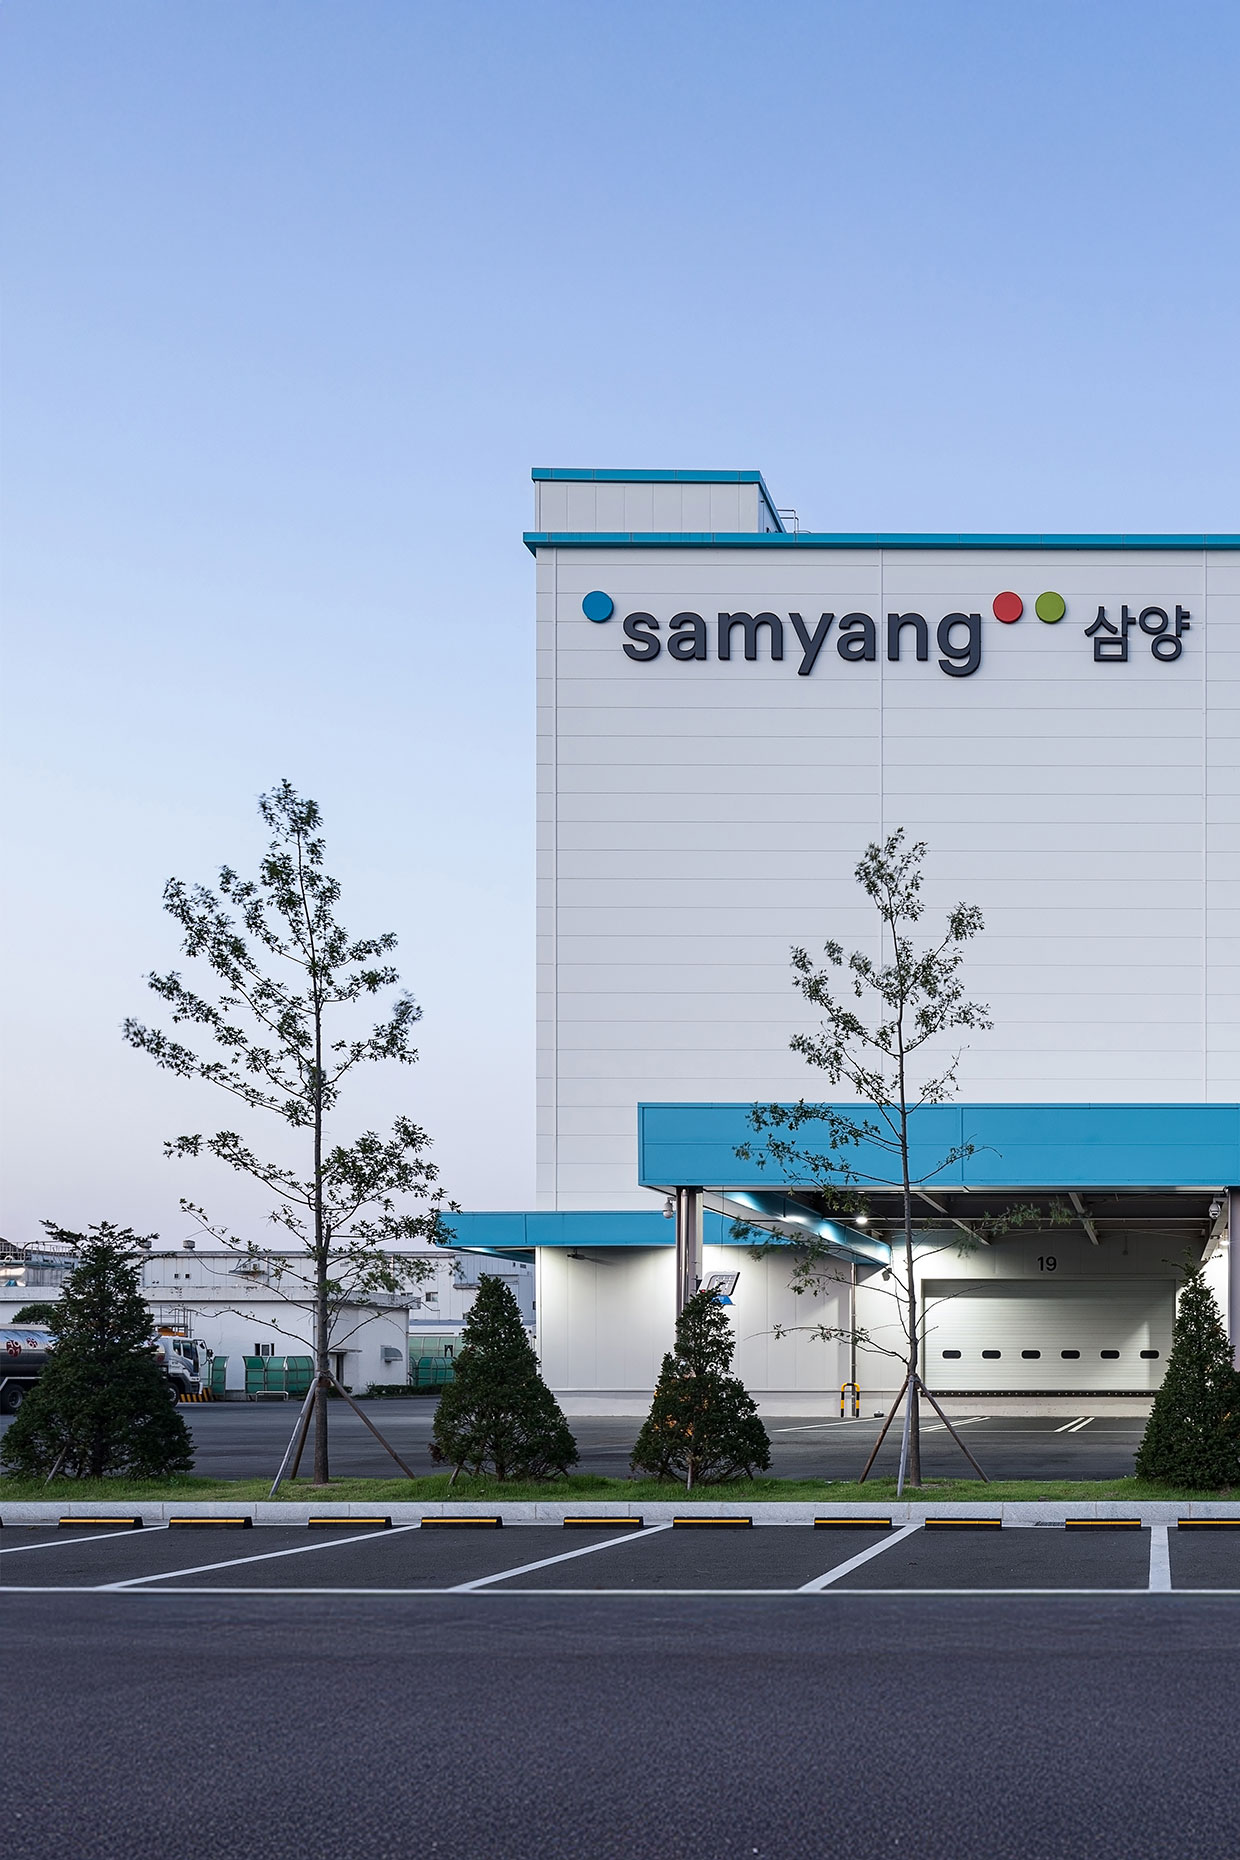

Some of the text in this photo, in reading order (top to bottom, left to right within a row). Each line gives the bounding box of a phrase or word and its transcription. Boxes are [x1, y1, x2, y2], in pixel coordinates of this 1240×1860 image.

[622, 611, 983, 677] samyang
[1084, 604, 1191, 663] 삼양
[1037, 1256, 1057, 1272] 19
